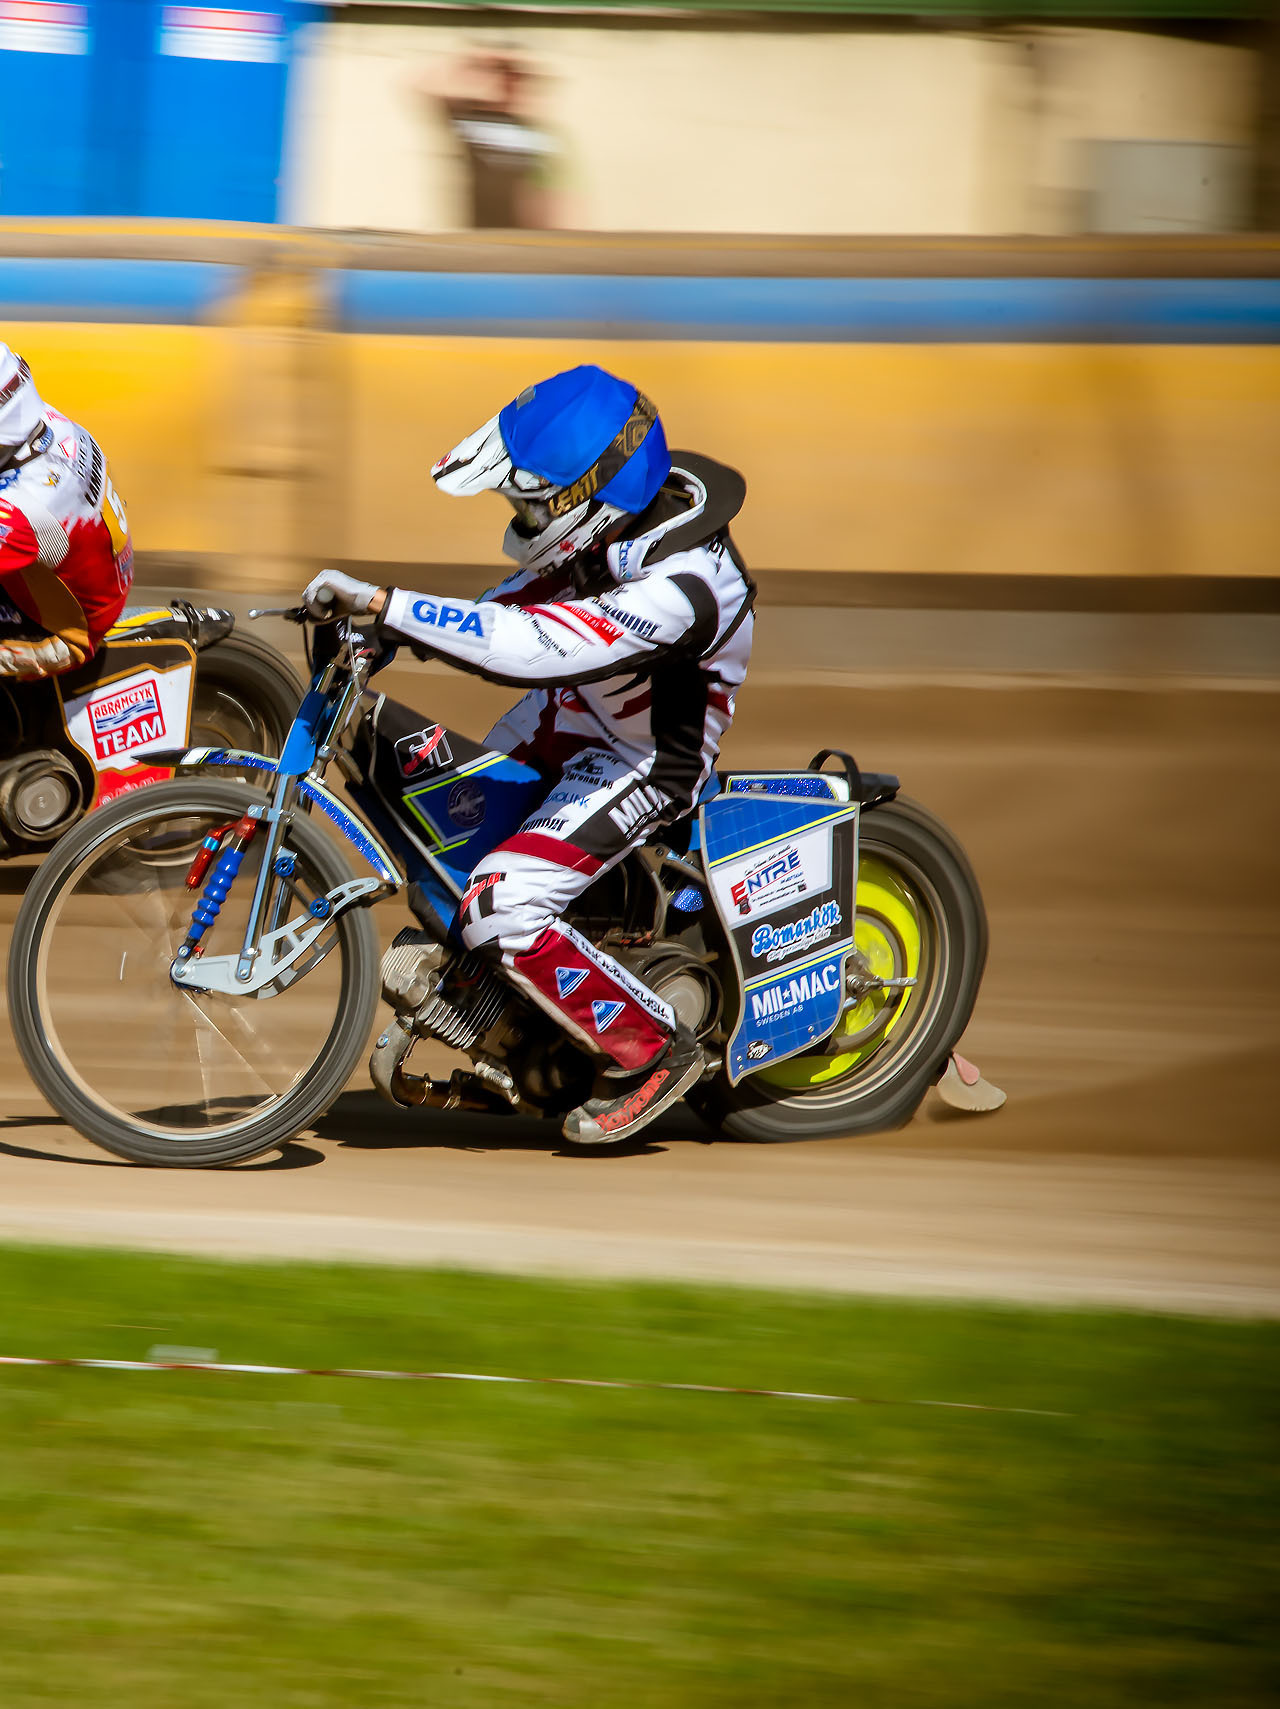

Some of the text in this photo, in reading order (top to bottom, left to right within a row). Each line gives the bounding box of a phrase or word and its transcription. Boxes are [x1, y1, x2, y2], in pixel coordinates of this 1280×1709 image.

[412, 599, 485, 638] GPA
[94, 687, 153, 719] ABRAMCZYK
[97, 714, 164, 757] TEAM
[730, 849, 801, 907] ENTRE
[752, 901, 841, 957] Bomankök
[755, 1004, 804, 1028] SWEDEN AB
